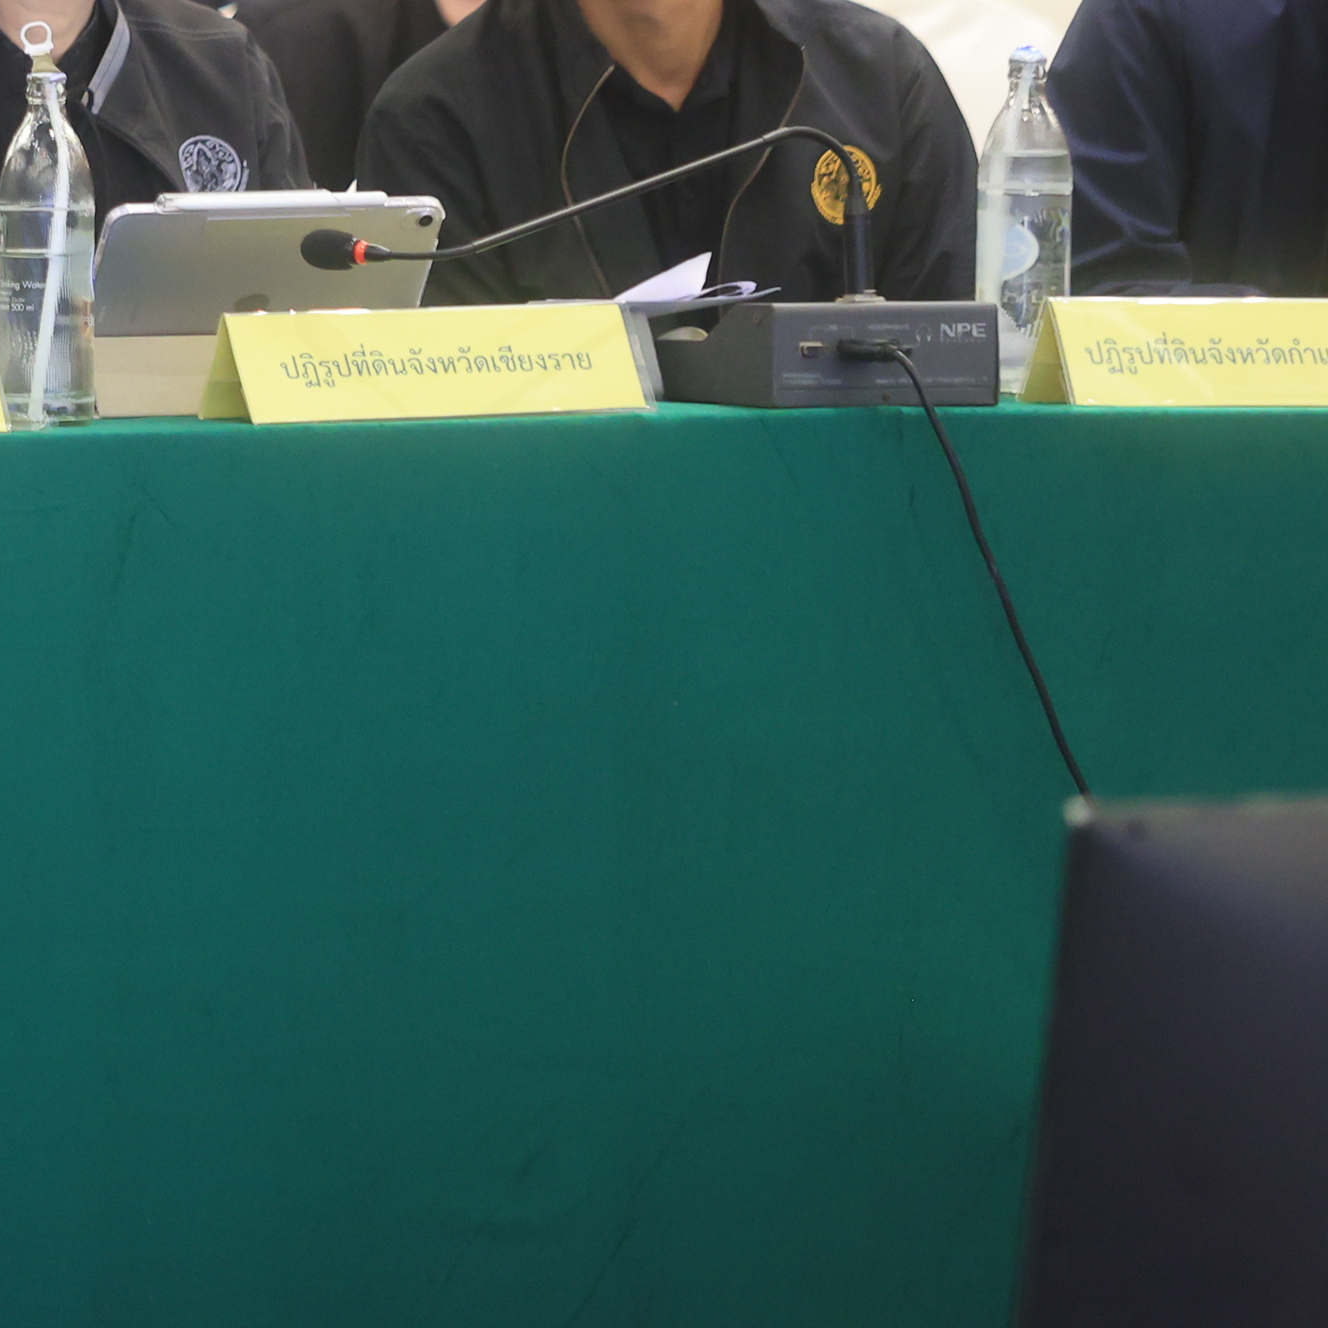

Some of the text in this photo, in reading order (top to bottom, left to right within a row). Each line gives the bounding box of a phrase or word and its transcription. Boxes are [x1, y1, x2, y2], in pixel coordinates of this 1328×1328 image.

[940, 323, 987, 338] NPE
[279, 344, 593, 388] ปฏิรูปที่ดินจังหวัดเชียงราย
